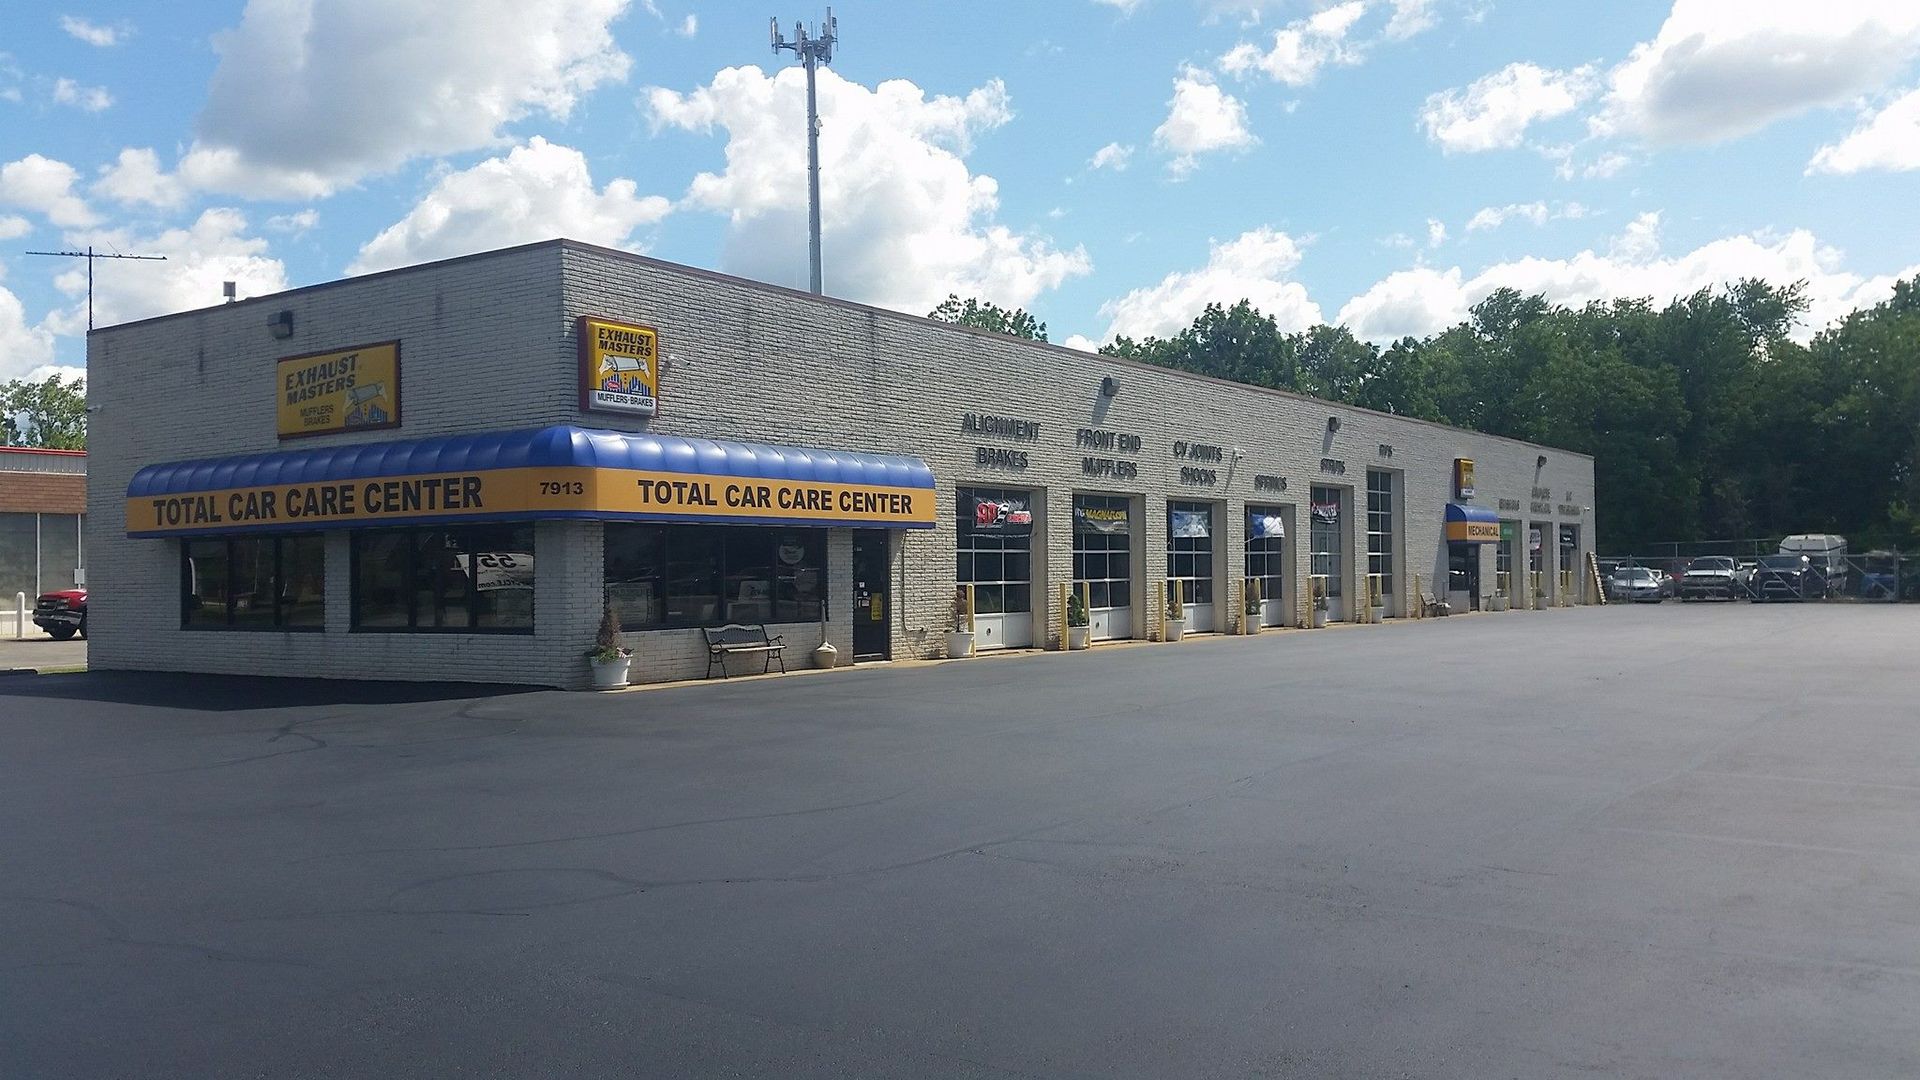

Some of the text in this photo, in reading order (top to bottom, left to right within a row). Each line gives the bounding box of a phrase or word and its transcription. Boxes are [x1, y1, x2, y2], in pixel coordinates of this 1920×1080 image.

[599, 328, 652, 346] EXHAUST
[599, 340, 652, 357] MASTERS
[285, 353, 359, 391] EXHAUST
[287, 374, 356, 406] MASTERS
[962, 413, 1040, 441] ALIGNMENT
[1076, 428, 1142, 451] FRONT END
[976, 446, 1029, 469] BRAKES
[1082, 456, 1138, 477] MUFFLERS
[539, 481, 584, 496] 7913
[638, 479, 913, 515] TOTAL CAR CARE CENTER
[153, 476, 483, 525] TOTAL CAR CARE CENTER
[1468, 525, 1499, 537] MECHANICAL
